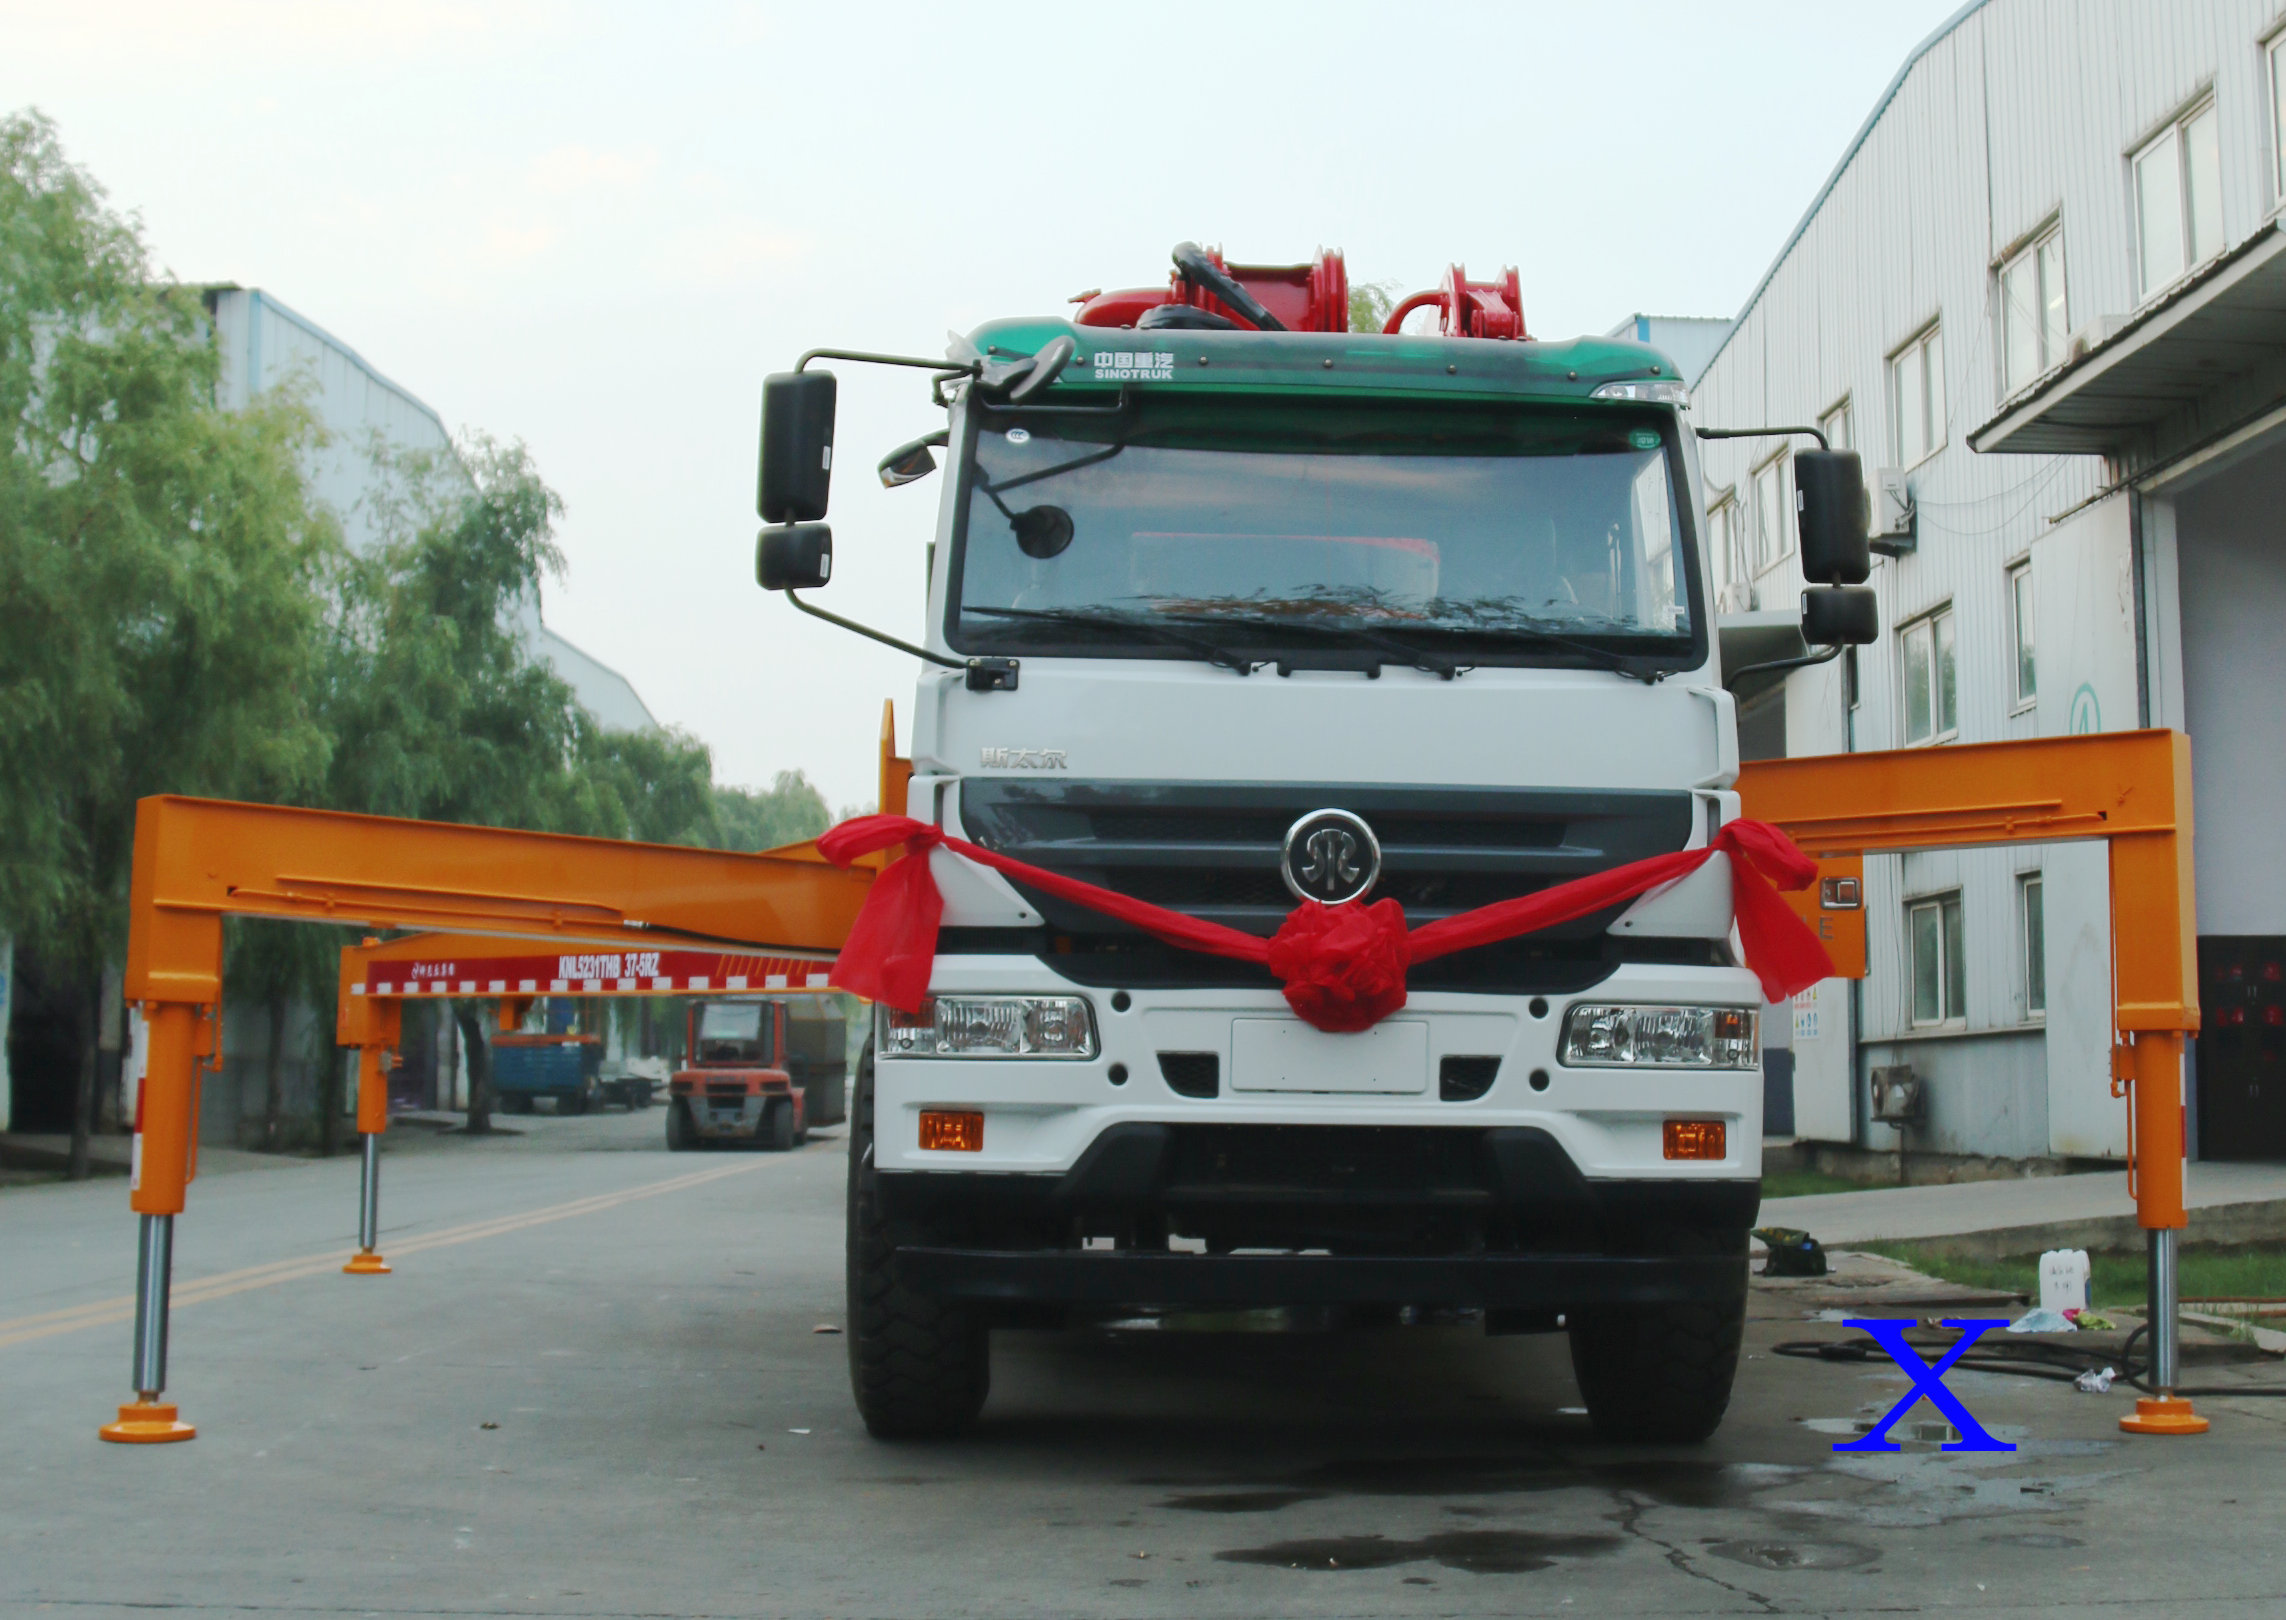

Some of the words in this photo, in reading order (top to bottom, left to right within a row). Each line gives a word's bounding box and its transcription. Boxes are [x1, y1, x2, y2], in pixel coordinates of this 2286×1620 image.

[1093, 352, 1175, 368] 中国重汽
[1095, 369, 1174, 380] SINOTRUK
